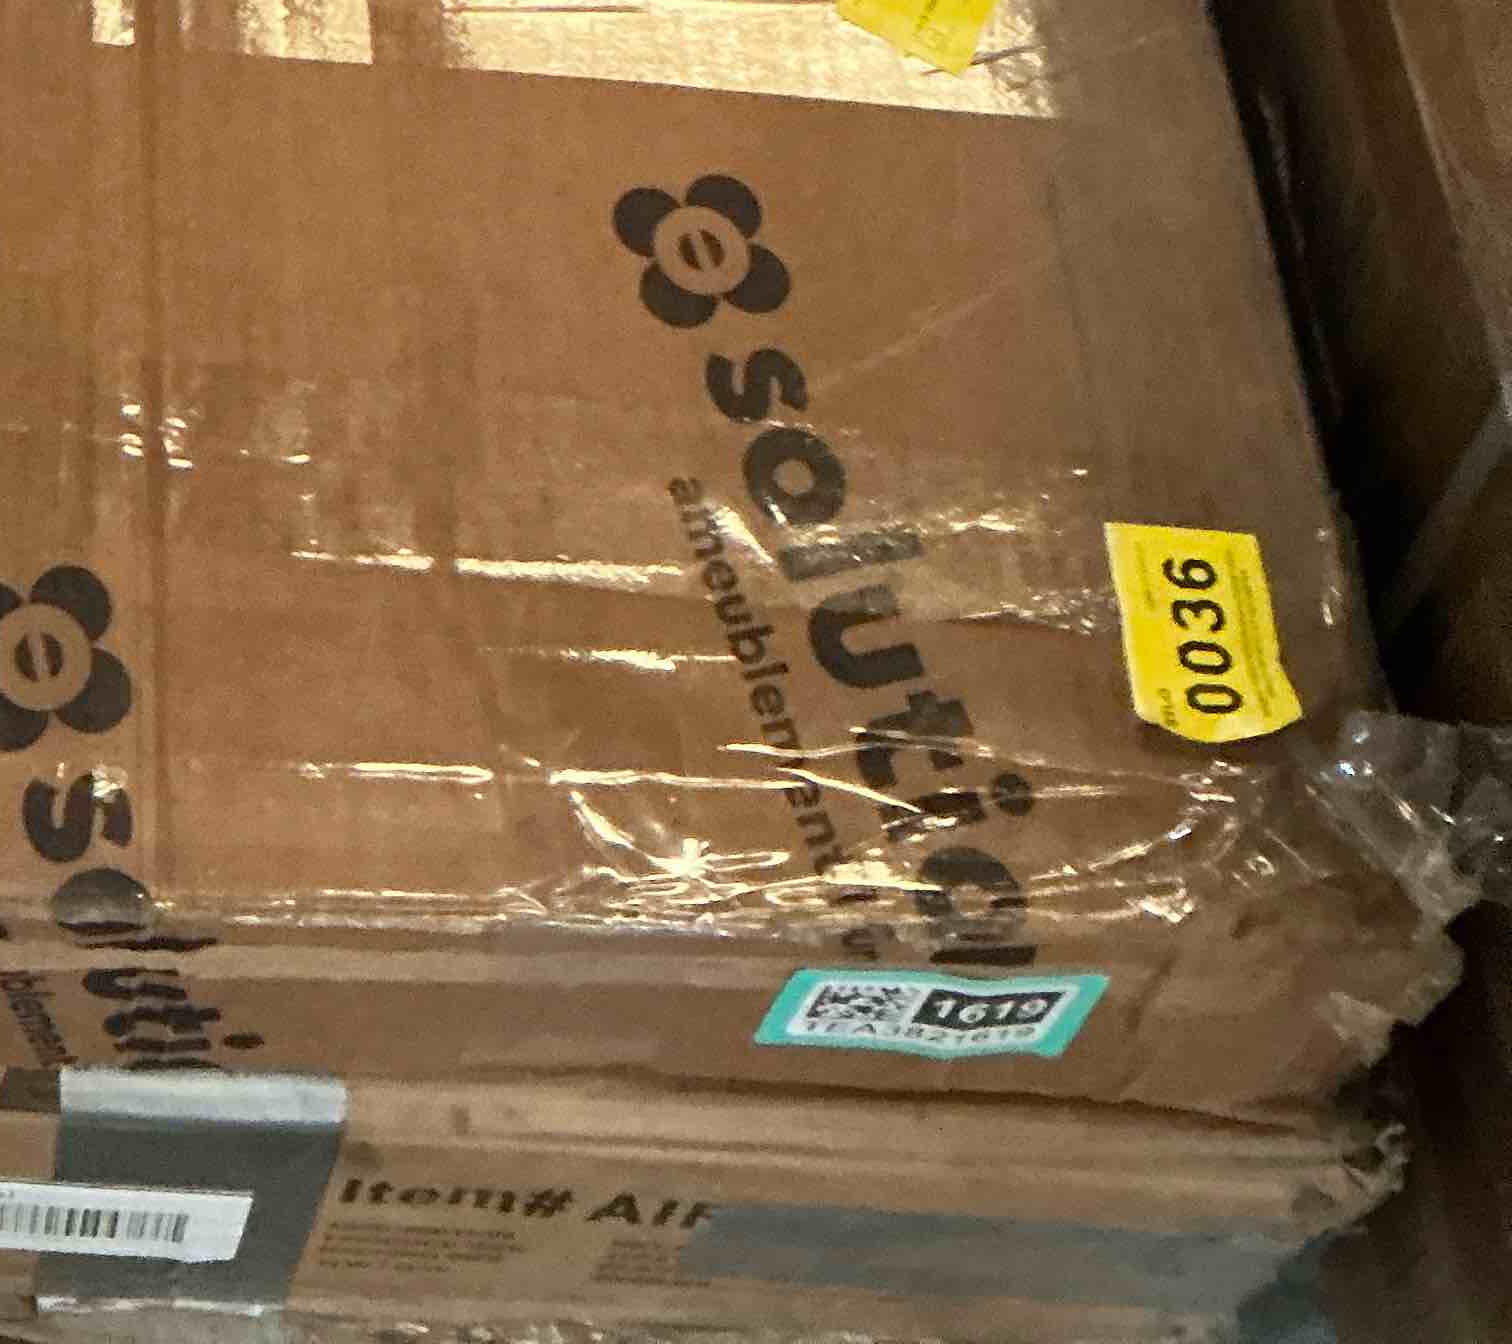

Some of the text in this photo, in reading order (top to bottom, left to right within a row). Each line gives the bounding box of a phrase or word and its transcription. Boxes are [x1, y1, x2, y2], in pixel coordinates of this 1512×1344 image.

[1165, 555, 1242, 716] 0036
[933, 993, 1049, 1027] 1619
[337, 1175, 577, 1220] Item#
